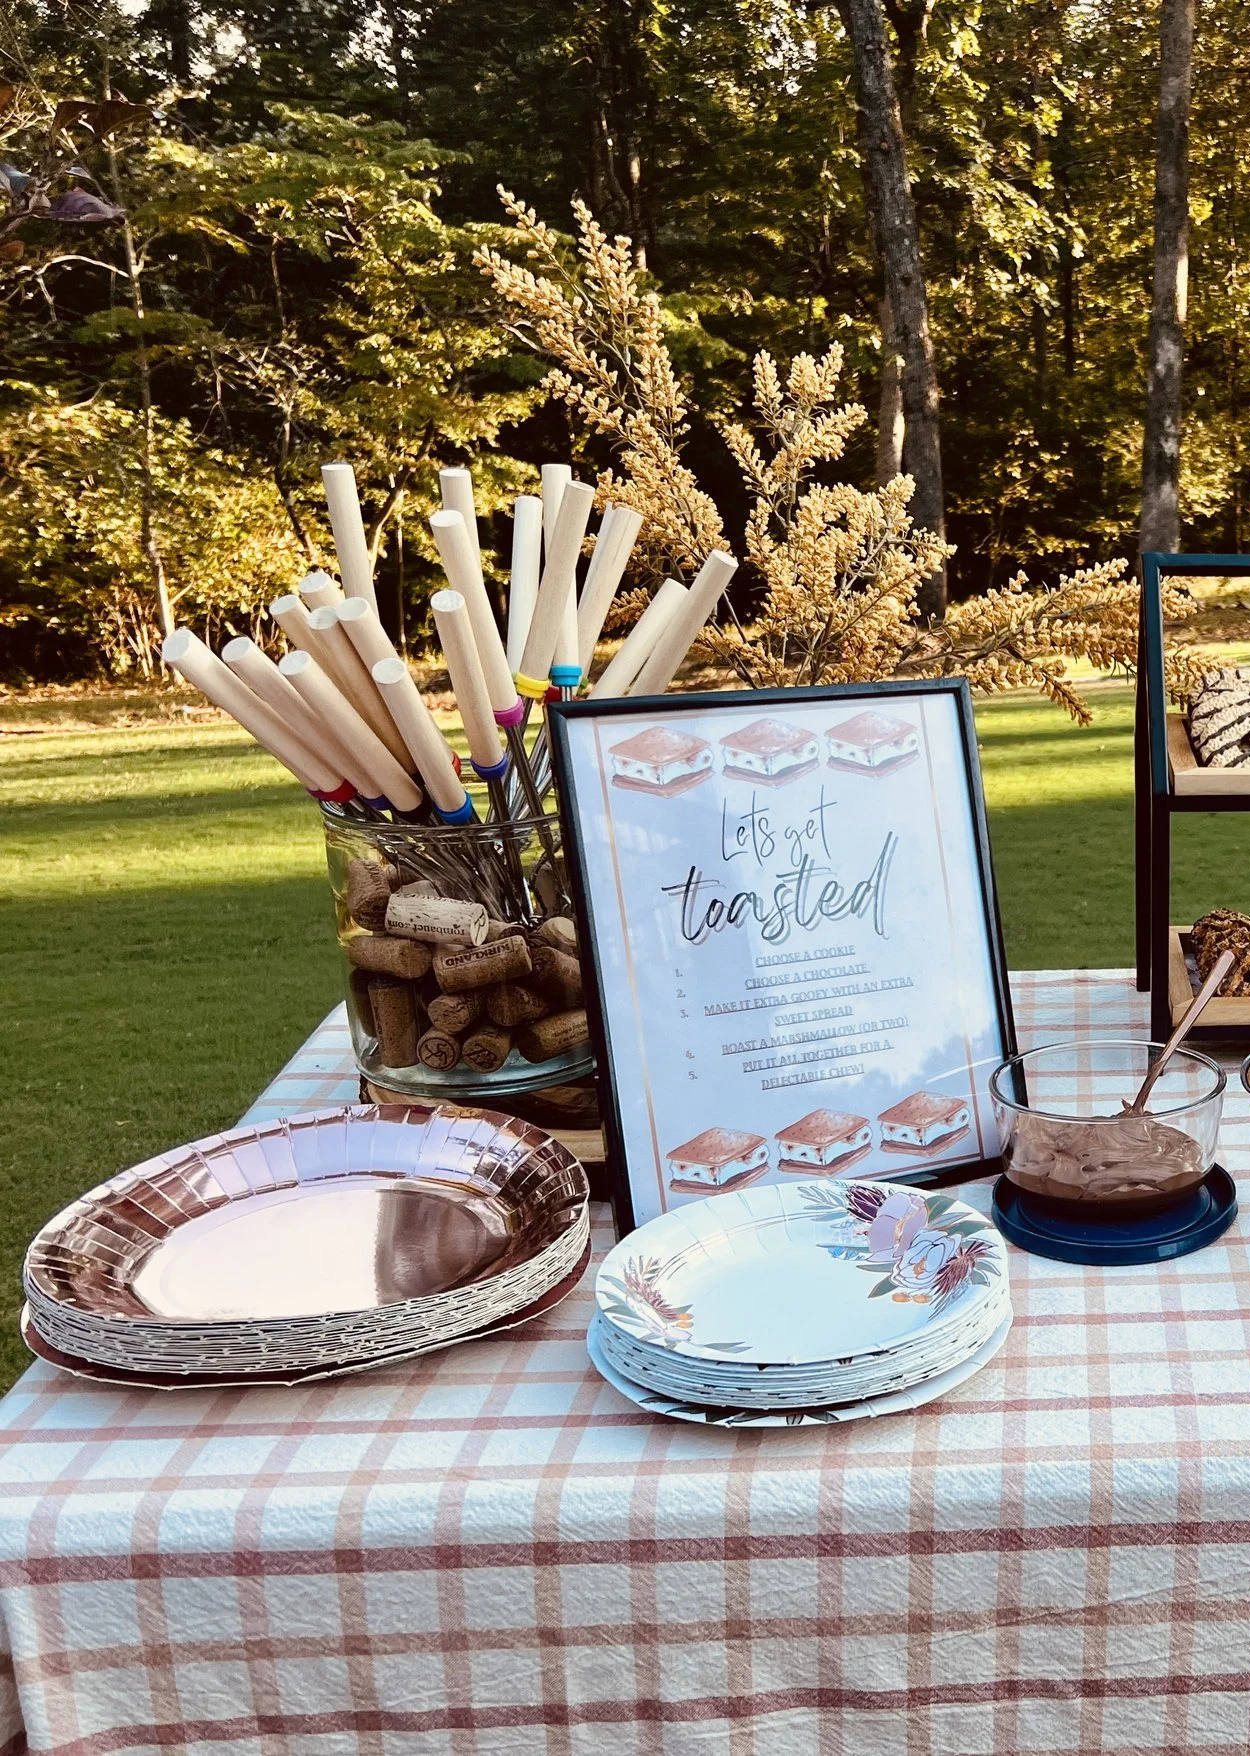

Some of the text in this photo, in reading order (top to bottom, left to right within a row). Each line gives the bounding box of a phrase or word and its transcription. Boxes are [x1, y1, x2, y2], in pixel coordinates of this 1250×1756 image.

[721, 784, 838, 867] Lets get
[661, 831, 899, 945] toasted
[445, 943, 509, 967] KIRKLAND
[755, 945, 855, 966] CHOOSE A COOKIE
[745, 963, 868, 989] CHOOSE A CHOCOLATE
[704, 1002, 737, 1016] MAKE
[739, 999, 752, 1011] IT
[753, 994, 788, 1009] EXTRA
[831, 983, 861, 997] WITH
[863, 980, 878, 992] AN
[880, 977, 913, 990] EXTRA
[774, 1005, 853, 1026] SWEET SPREAD
[721, 1014, 909, 1055] ROAST A MARSHMALLOW (OR TWO)
[742, 1039, 892, 1073] PUT IT ALL TOGETHER FOR A
[761, 1063, 864, 1089] DELECTABLE CHEW!
